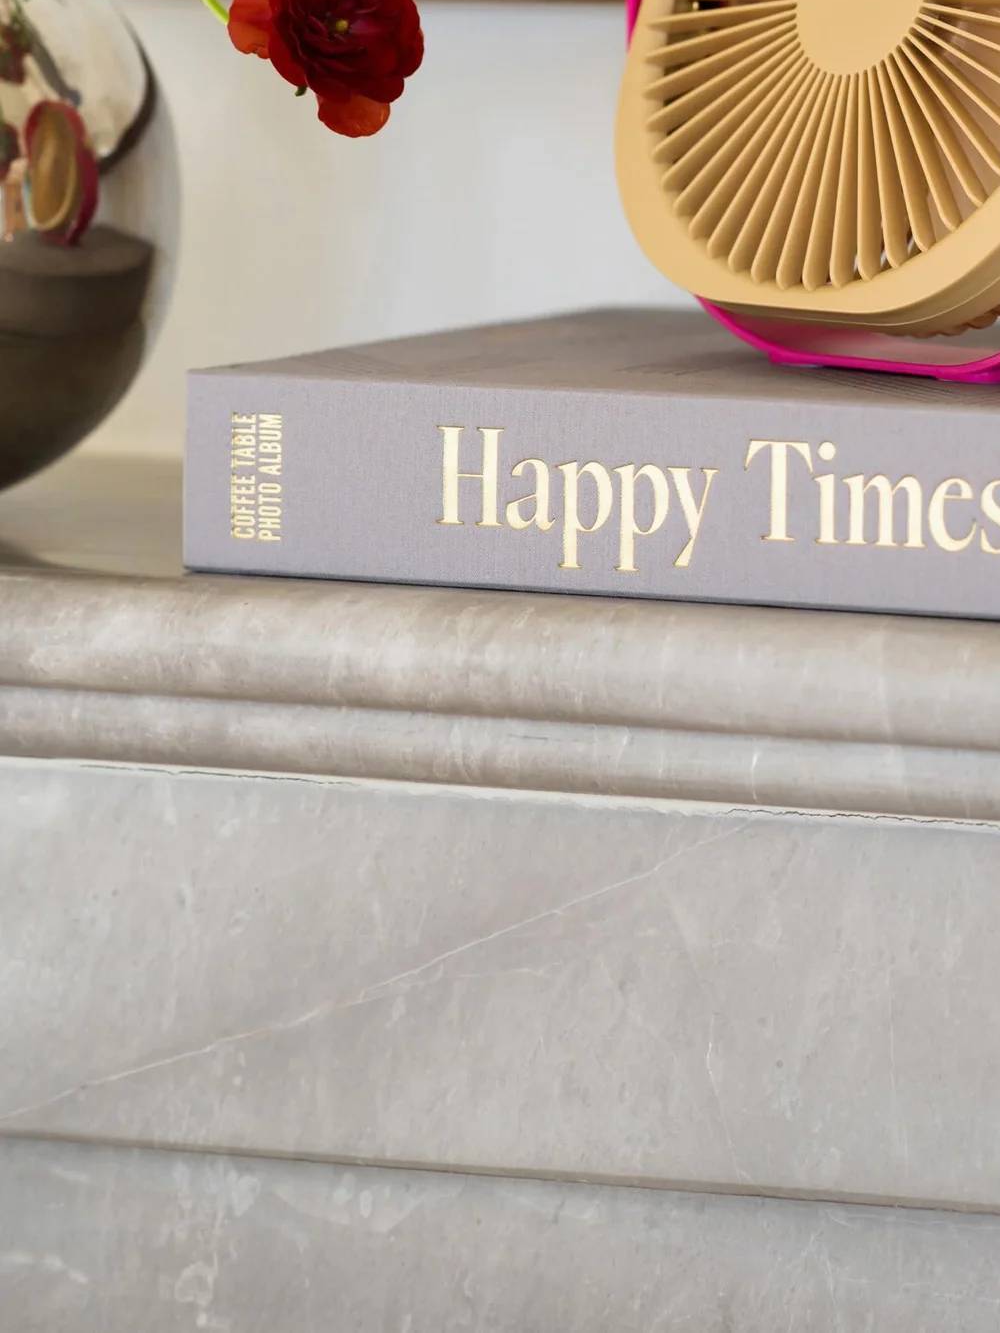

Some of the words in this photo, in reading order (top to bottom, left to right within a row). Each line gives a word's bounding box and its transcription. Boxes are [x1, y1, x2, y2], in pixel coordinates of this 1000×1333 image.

[231, 412, 257, 467] TABLE
[258, 413, 283, 476] ALBUM
[230, 474, 256, 540] COFFEE
[258, 482, 283, 542] PHOTO
[436, 425, 718, 573] Happy
